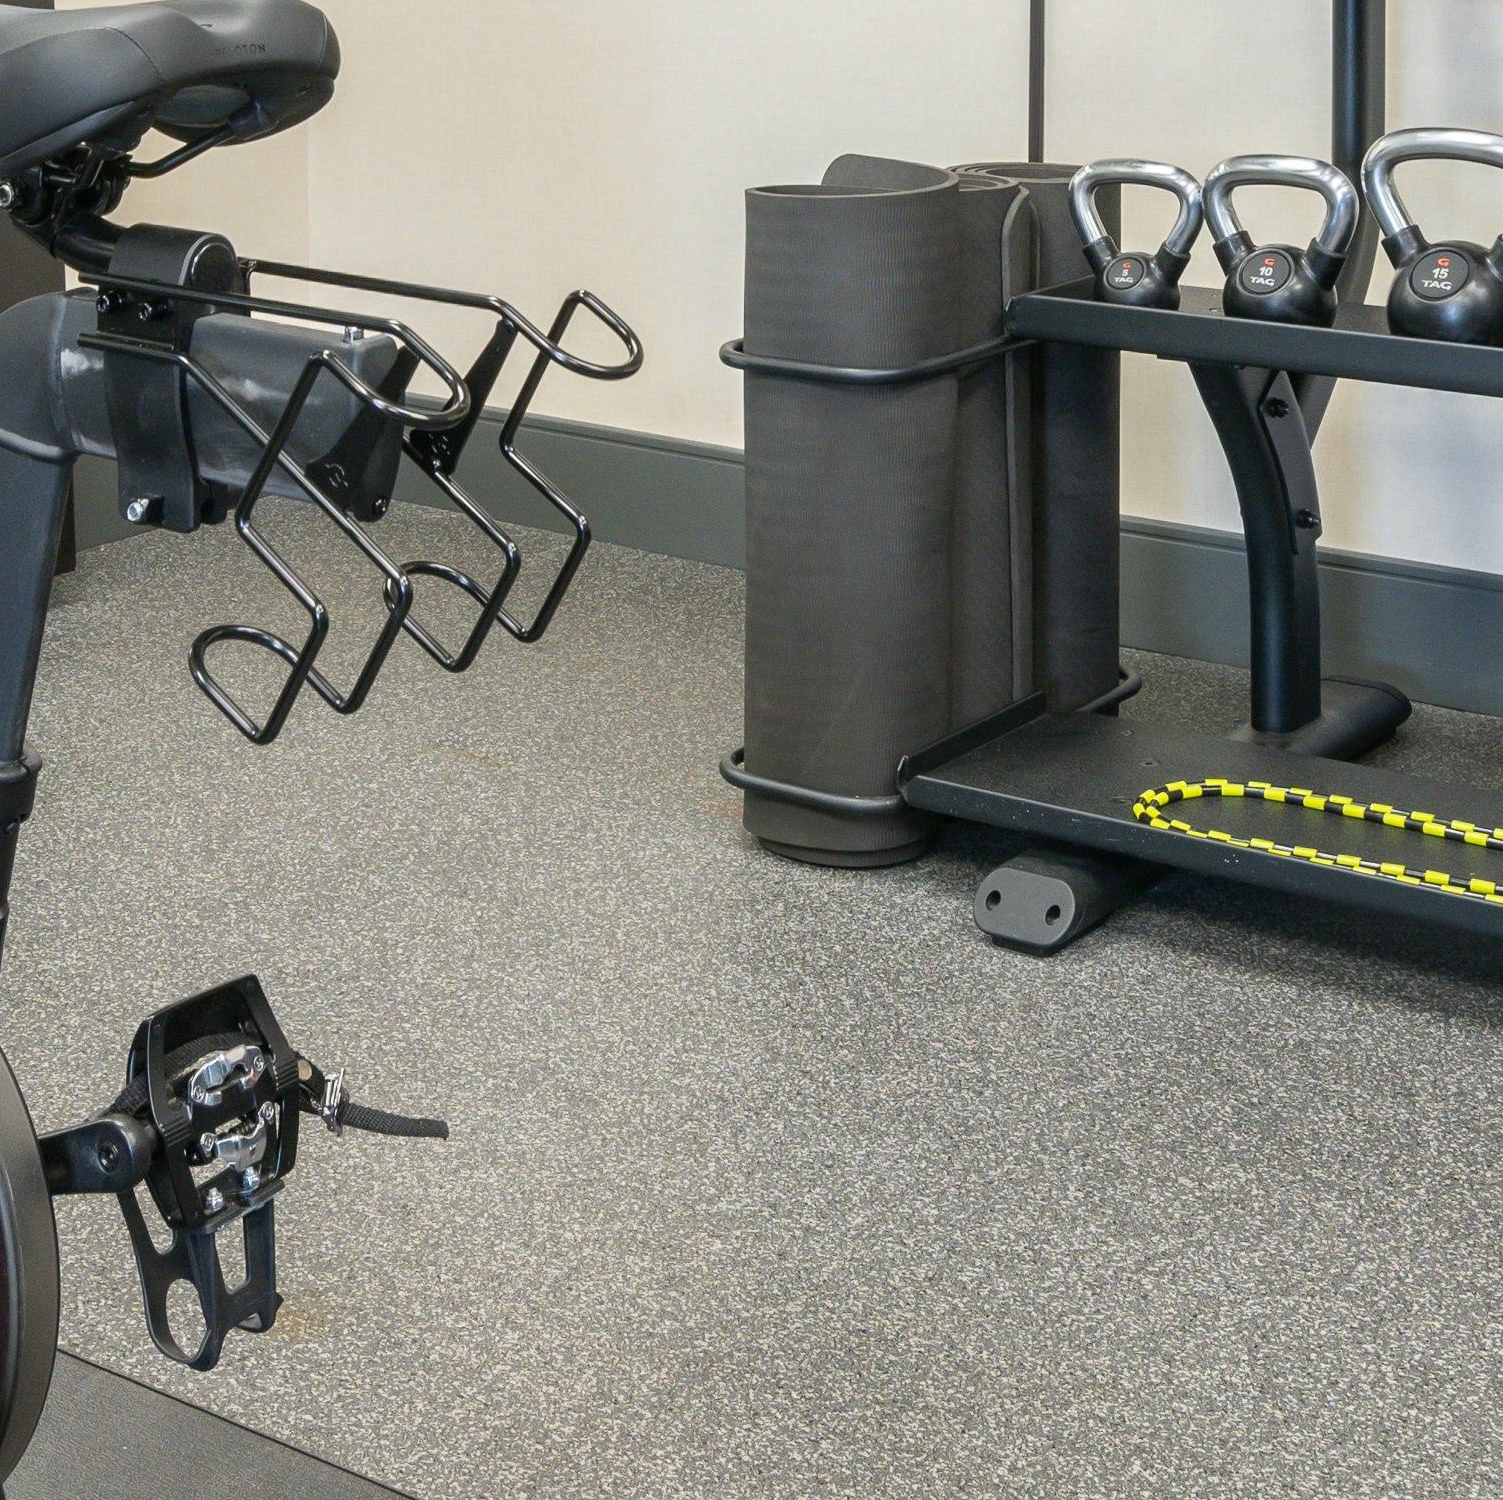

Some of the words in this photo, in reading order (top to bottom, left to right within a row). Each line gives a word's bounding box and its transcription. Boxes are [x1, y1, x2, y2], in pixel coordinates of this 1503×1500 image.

[1121, 269, 1129, 277] 5
[1259, 265, 1274, 277] 10
[1432, 267, 1450, 279] 15
[1113, 276, 1134, 284] TAG
[1249, 275, 1276, 287] TAG
[1421, 279, 1453, 291] TAG
